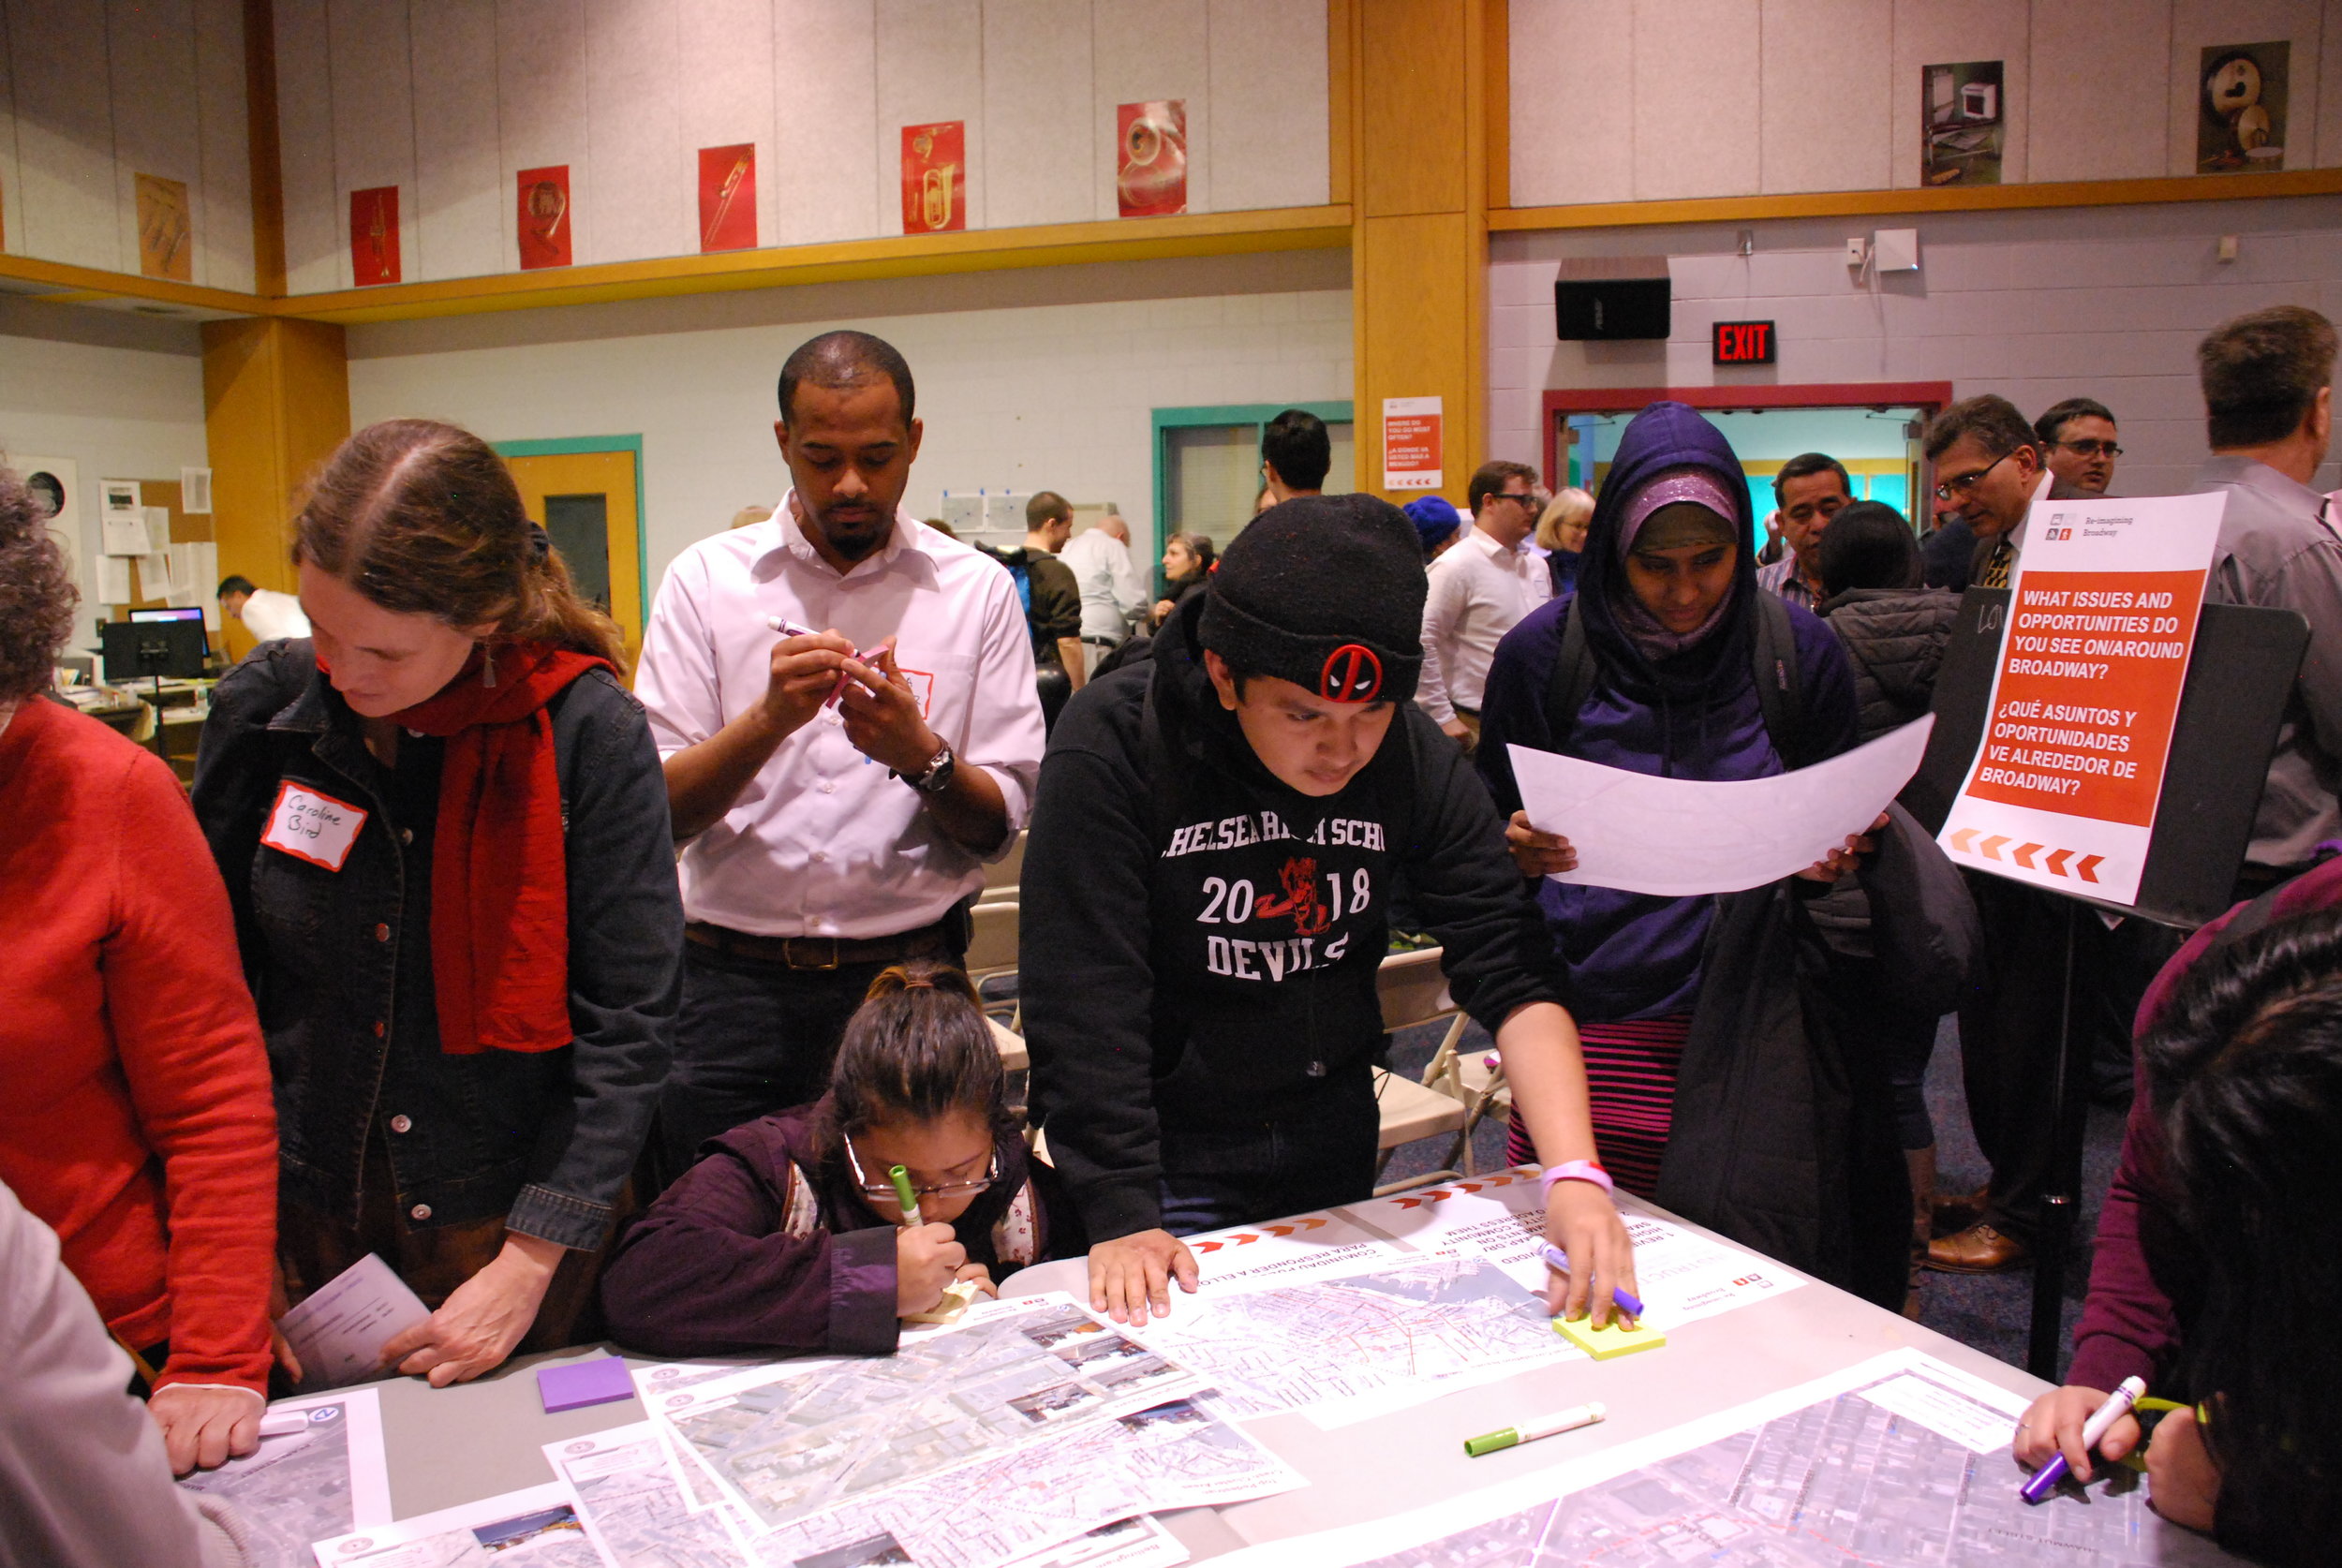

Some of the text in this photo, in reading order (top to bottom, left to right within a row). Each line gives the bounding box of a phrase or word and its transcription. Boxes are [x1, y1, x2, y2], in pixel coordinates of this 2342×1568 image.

[1719, 324, 1769, 360] EXIT
[2085, 517, 2133, 525] Re-imagining
[2083, 528, 2117, 538] Broadway
[2023, 591, 2172, 609] WHAT ISSUES AND
[2018, 613, 2178, 633] OPPORTUNITIES DO
[2014, 636, 2184, 658] YOU SEE ON/AROUND
[2008, 658, 2109, 679] BROADWAY?
[1998, 700, 2137, 727] ¿QUÉ ASUNTOS Y
[1994, 723, 2130, 752] OPORTUNIDADES
[1989, 745, 2137, 778] VE ALREDEDOR DE
[1979, 767, 2081, 795] BROADWAY?
[289, 795, 340, 825] Caroline
[288, 815, 321, 838] Bird
[1161, 810, 1386, 858] HELSEA HIH SCH
[1442, 1225, 1512, 1246] COMMUNITY
[1330, 1243, 1367, 1254] PARA
[1250, 1251, 1331, 1274] RESPONDER
